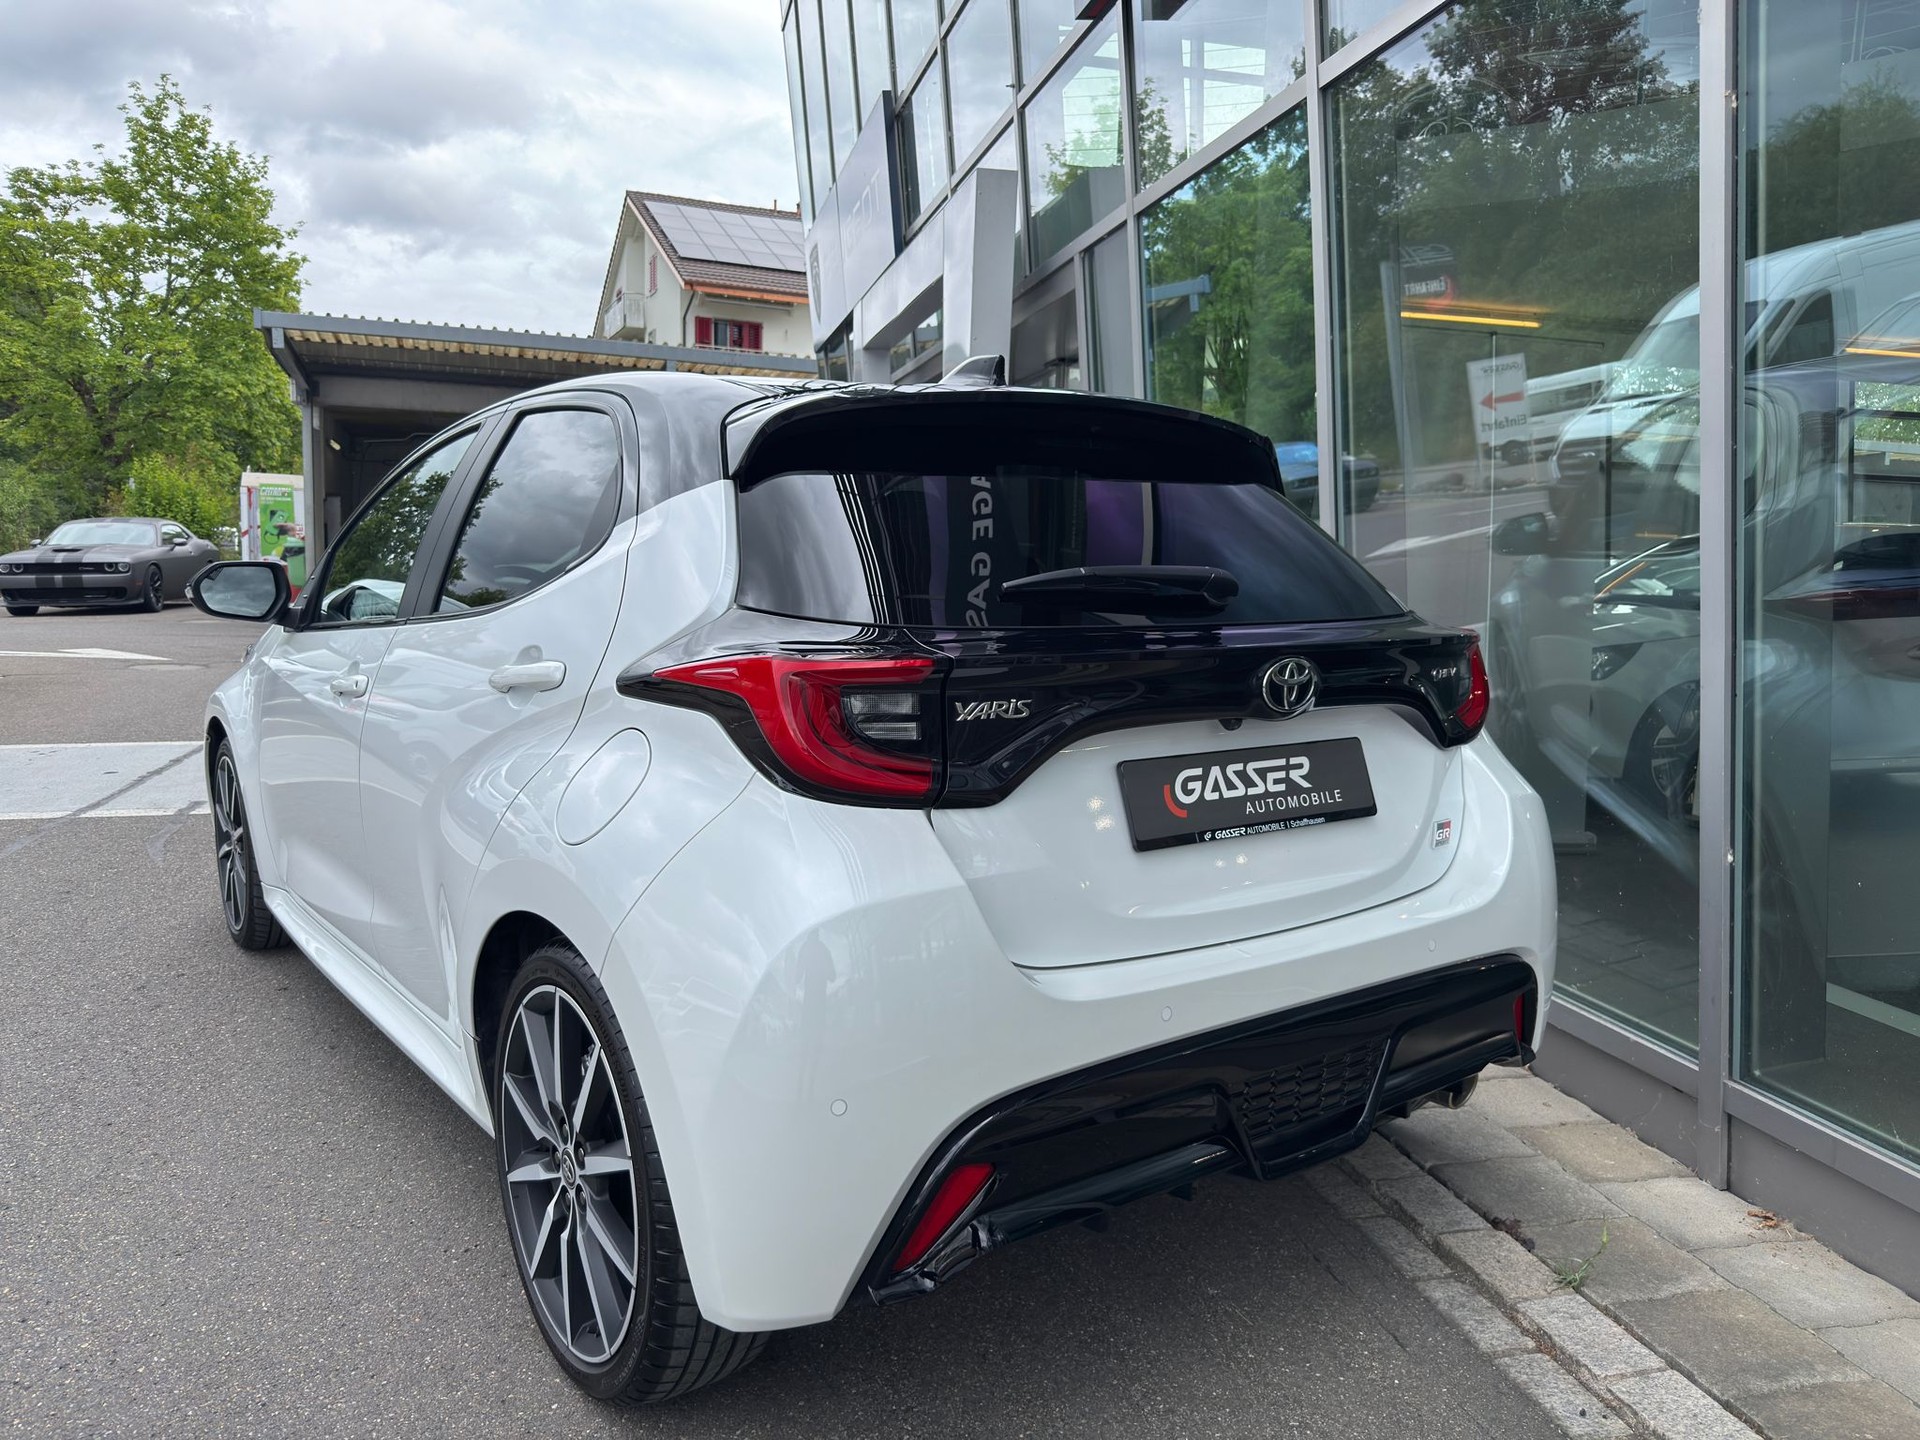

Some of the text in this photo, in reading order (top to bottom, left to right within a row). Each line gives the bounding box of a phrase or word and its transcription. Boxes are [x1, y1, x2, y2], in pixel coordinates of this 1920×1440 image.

[1174, 756, 1313, 805] GASSER
[1245, 789, 1344, 815] AUTOMOBILE
[1215, 827, 1247, 840] GASSER
[1247, 821, 1286, 835] AUTOMOBILE
[1291, 816, 1326, 829] Schaffhausen
